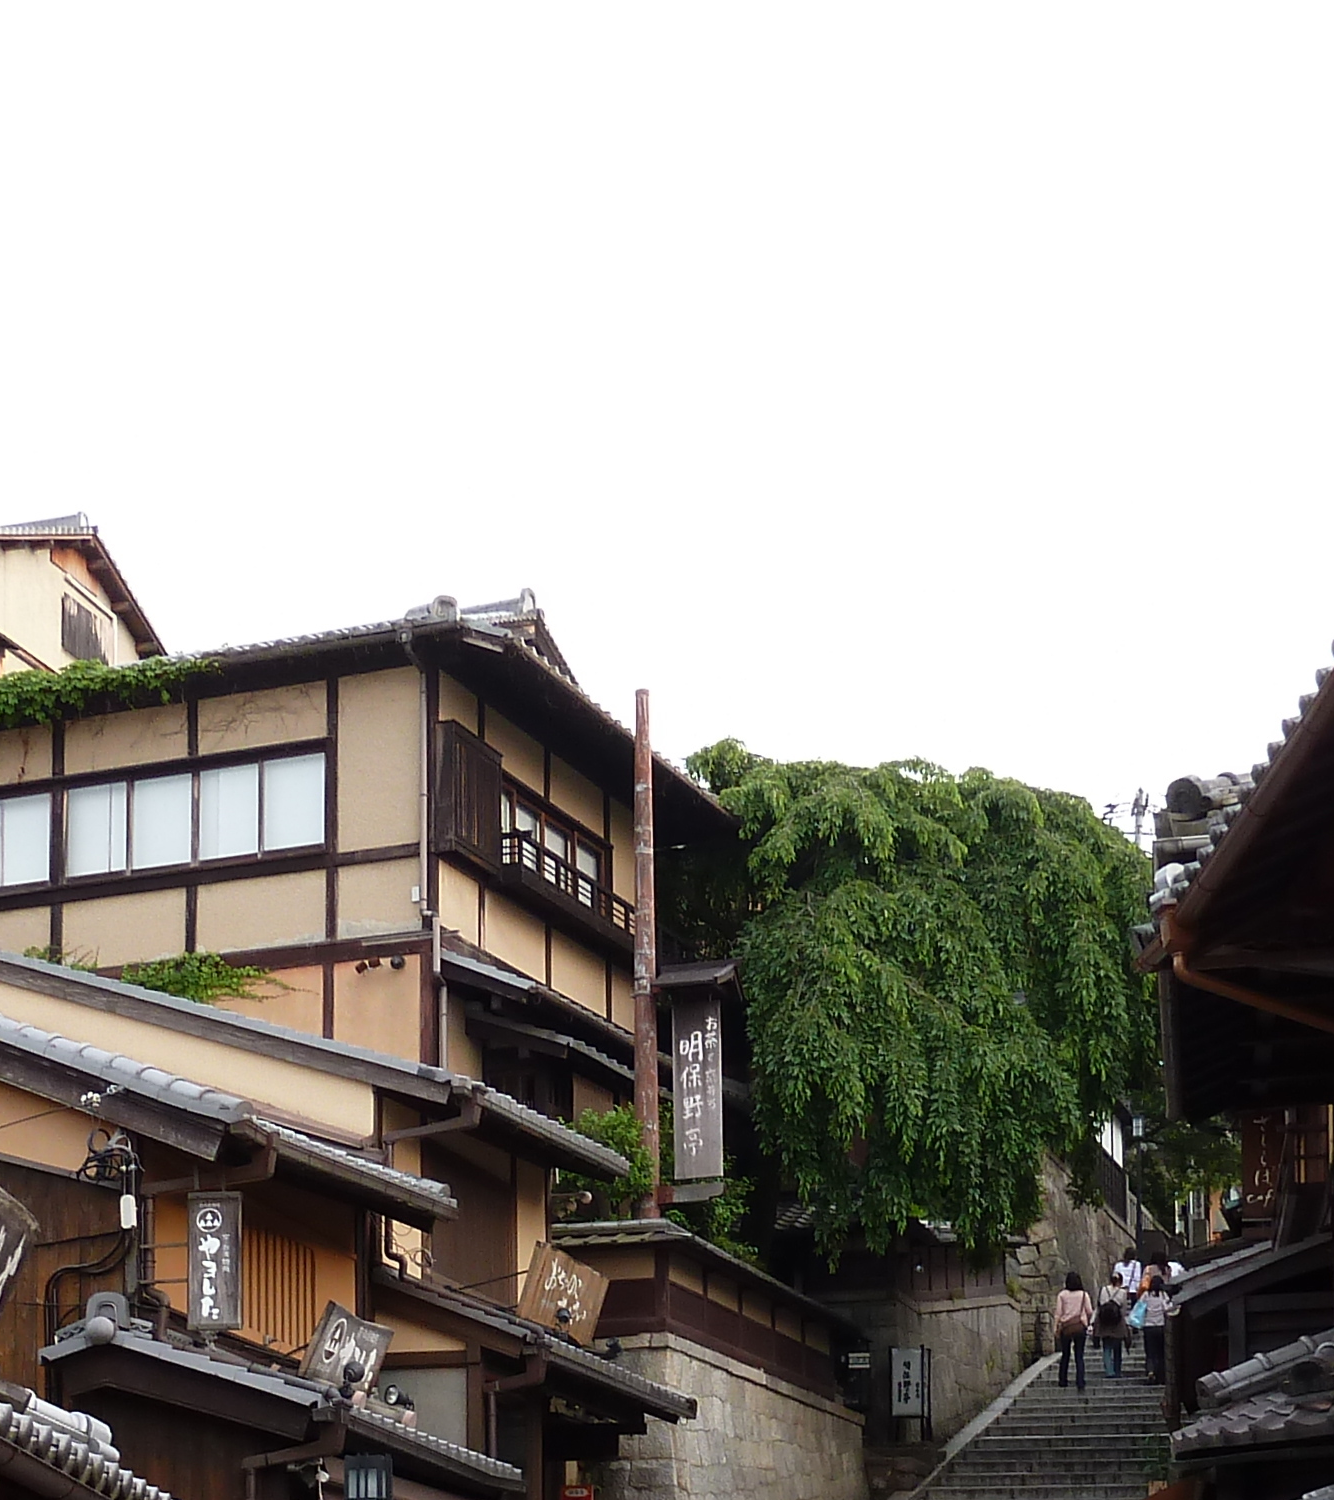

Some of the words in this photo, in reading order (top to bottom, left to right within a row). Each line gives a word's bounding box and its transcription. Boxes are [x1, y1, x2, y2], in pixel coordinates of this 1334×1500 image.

[679, 1031, 704, 1156] 明保野亭
[1246, 1189, 1274, 1207] caf
